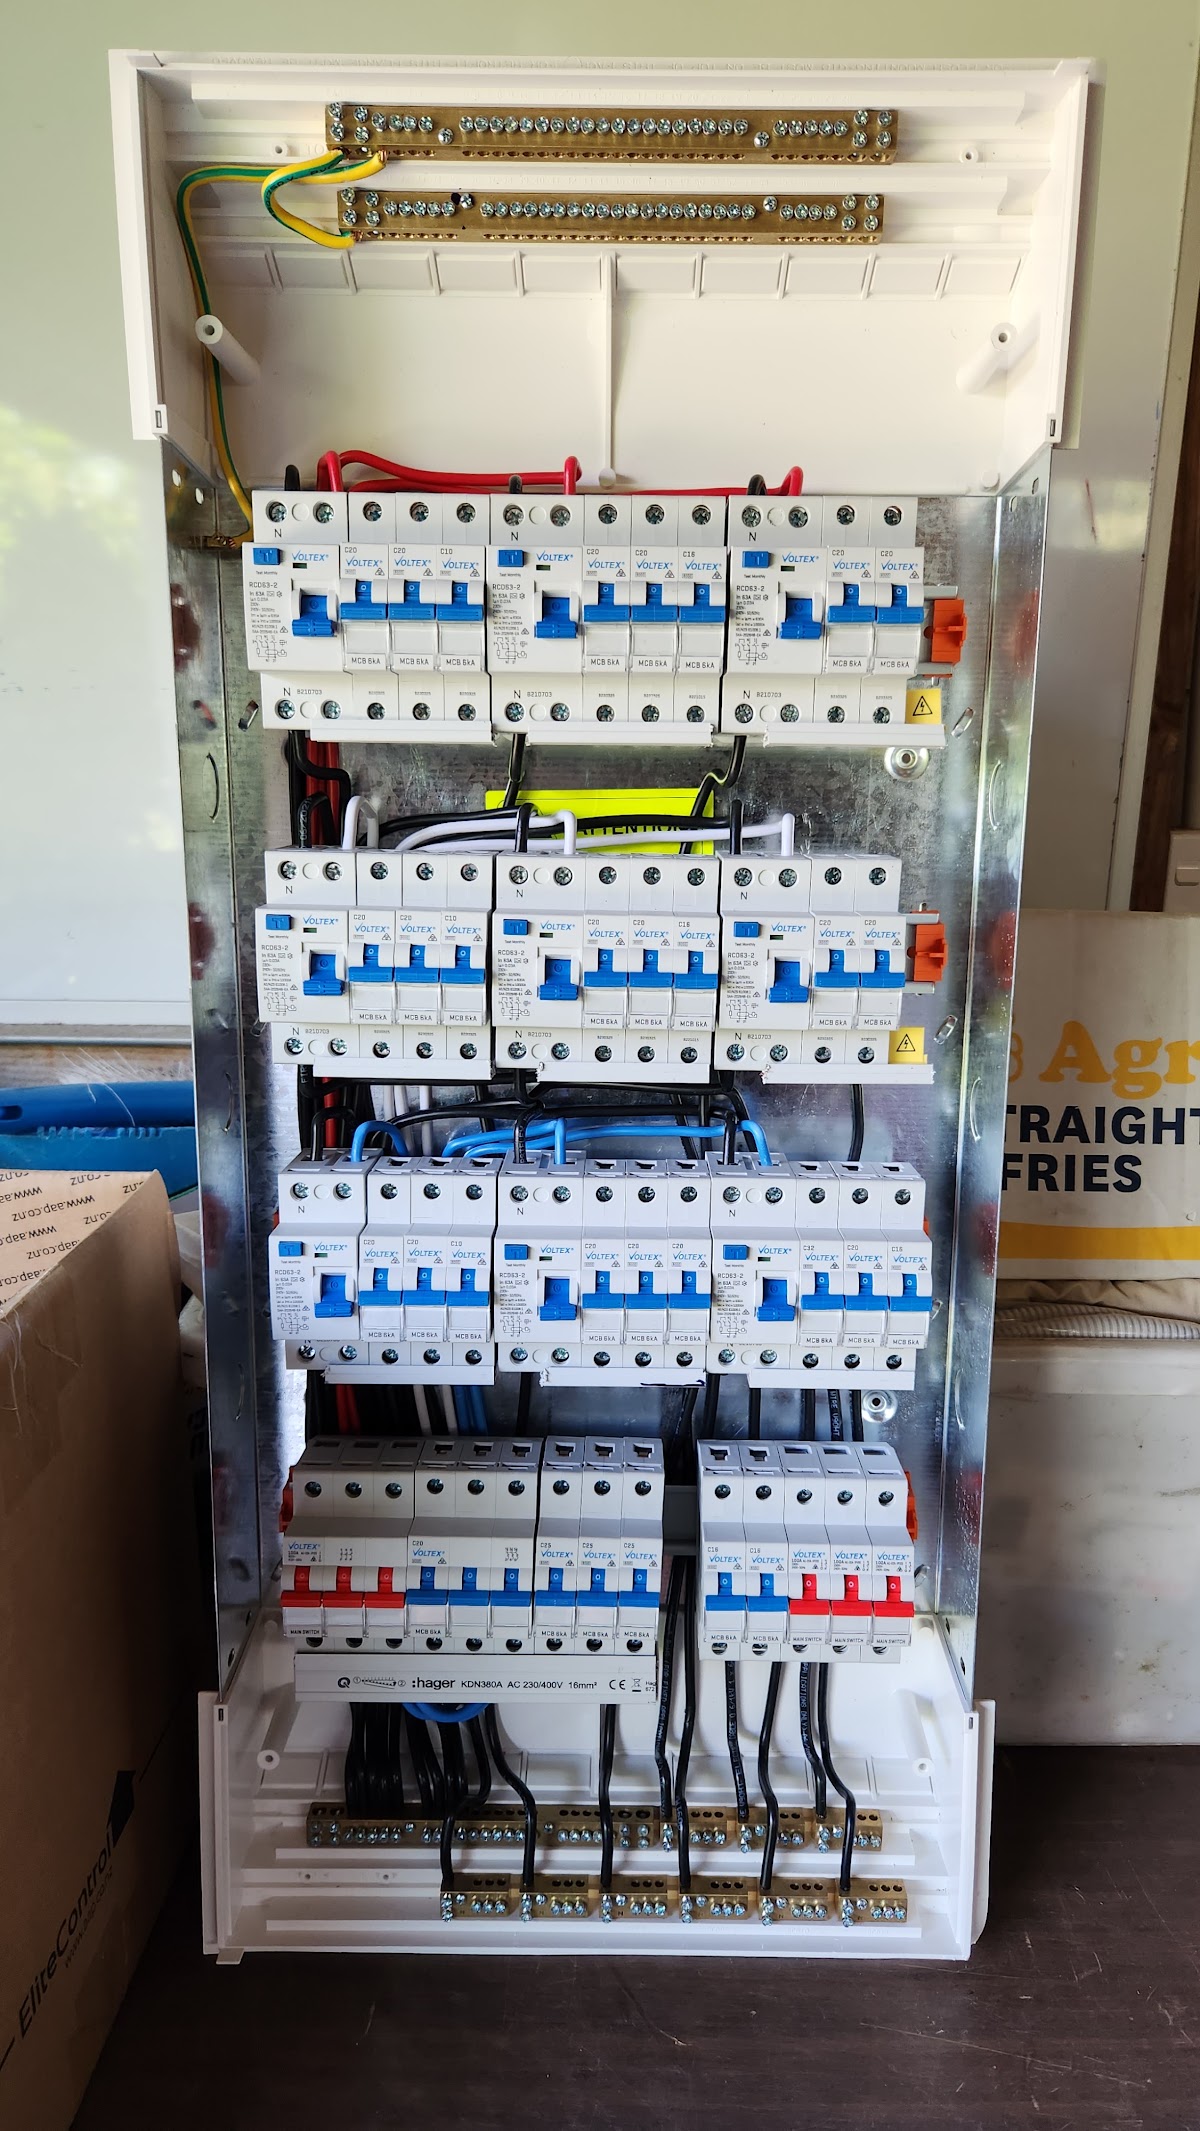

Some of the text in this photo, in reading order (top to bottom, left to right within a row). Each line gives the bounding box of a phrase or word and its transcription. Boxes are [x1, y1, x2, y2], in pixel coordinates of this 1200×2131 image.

[275, 529, 282, 537] N
[511, 532, 518, 540] N
[749, 533, 756, 541] N
[284, 687, 290, 695] N
[514, 690, 521, 698] N
[744, 691, 750, 699] N
[286, 886, 292, 894] N
[517, 890, 523, 898] N
[741, 892, 747, 900] N
[293, 1027, 299, 1035] N
[515, 1030, 522, 1038] N
[1002, 1153, 1142, 1192] FRIES
[11, 1195, 95, 1222] www.aap.co.nz
[523, 1681, 563, 1689] 230/400V
[18, 1829, 112, 2039] EliteControl
